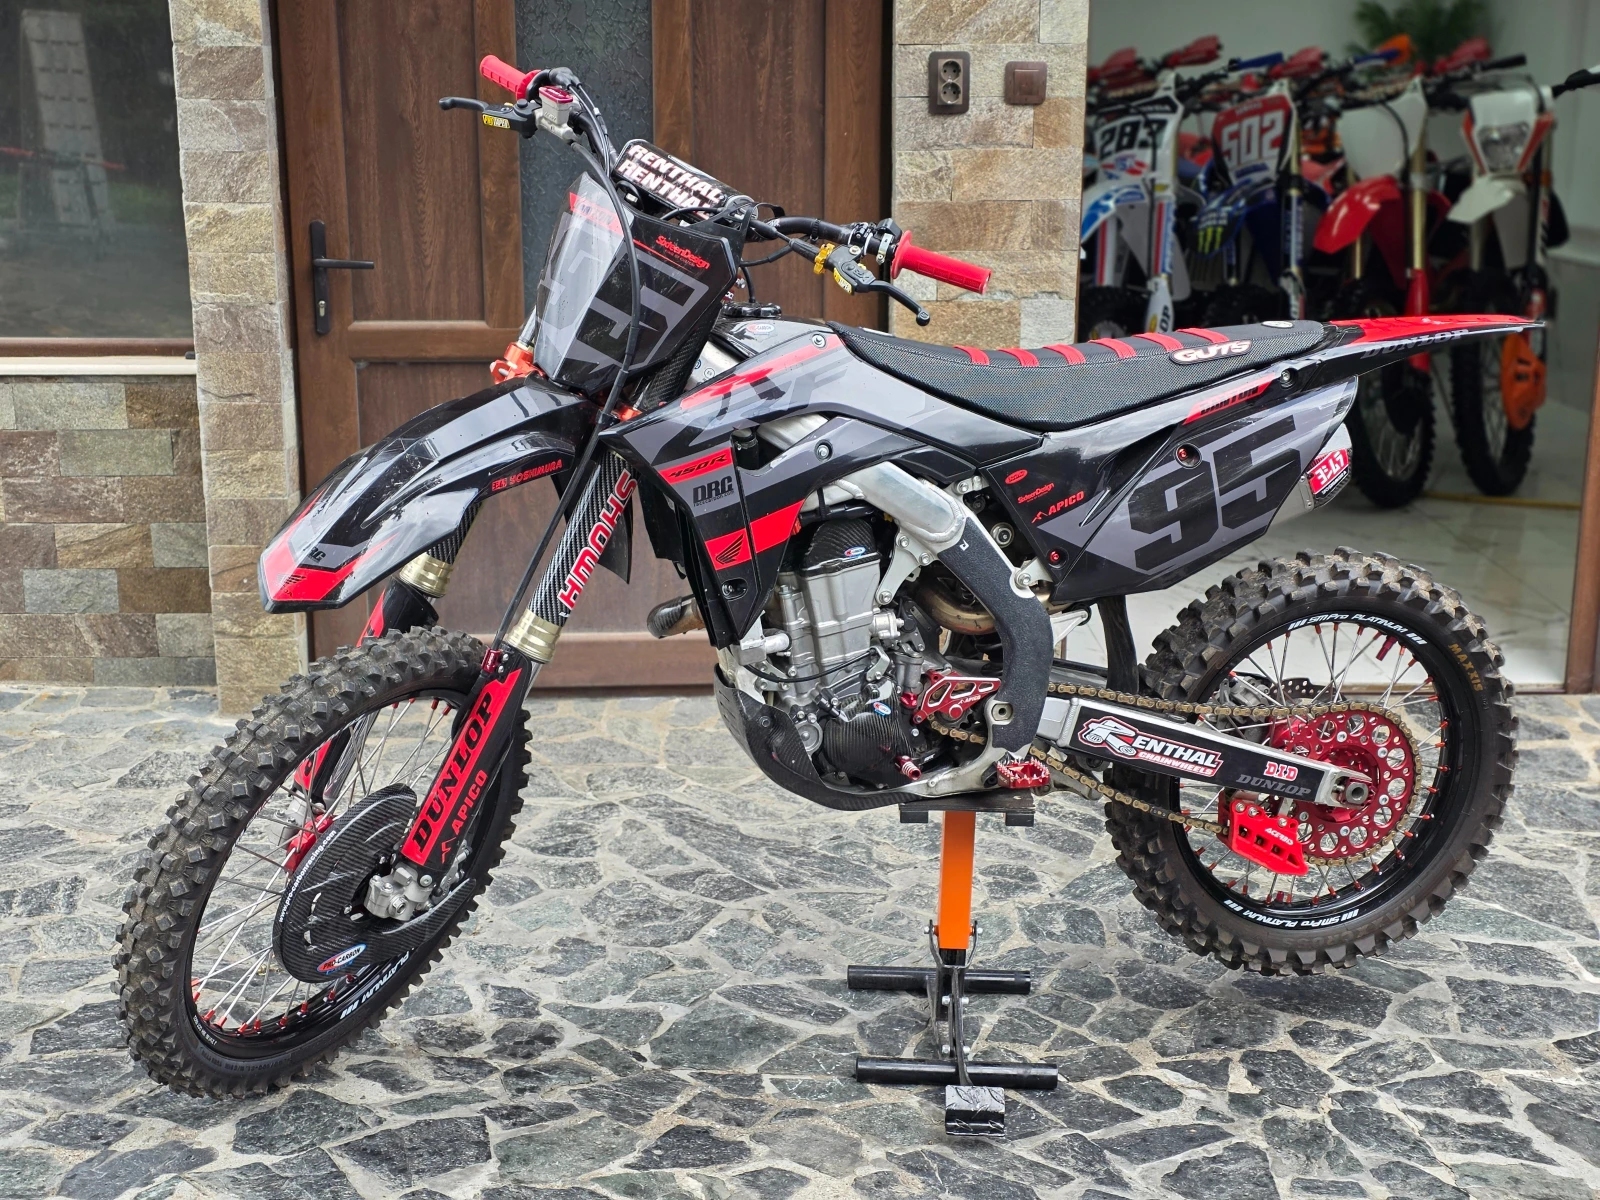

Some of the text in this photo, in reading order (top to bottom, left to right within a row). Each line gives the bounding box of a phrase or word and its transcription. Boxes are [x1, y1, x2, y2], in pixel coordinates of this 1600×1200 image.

[1221, 110, 1285, 170] 502
[627, 144, 724, 204] RENTHAL
[1174, 340, 1252, 363] GUTS
[1360, 329, 1469, 360] DUNLOP
[509, 459, 563, 486] YOSHIMURA
[668, 453, 728, 478] 450R
[693, 475, 734, 504] DRC
[1048, 490, 1085, 516] APICO
[1128, 415, 1301, 572] 95
[1351, 613, 1409, 634] PLATINUM
[1448, 643, 1485, 693] MAXXIS
[413, 691, 493, 854] DUNLOP
[1137, 750, 1215, 777] CHAINWHEELS
[1265, 761, 1299, 782] DID
[1236, 773, 1312, 798] DUNLOP
[451, 769, 488, 836] APICO
[278, 829, 337, 923] www.pro-carbonracing.com
[1242, 909, 1299, 928] PLATINUM
[361, 950, 410, 1004] PLATINUM
